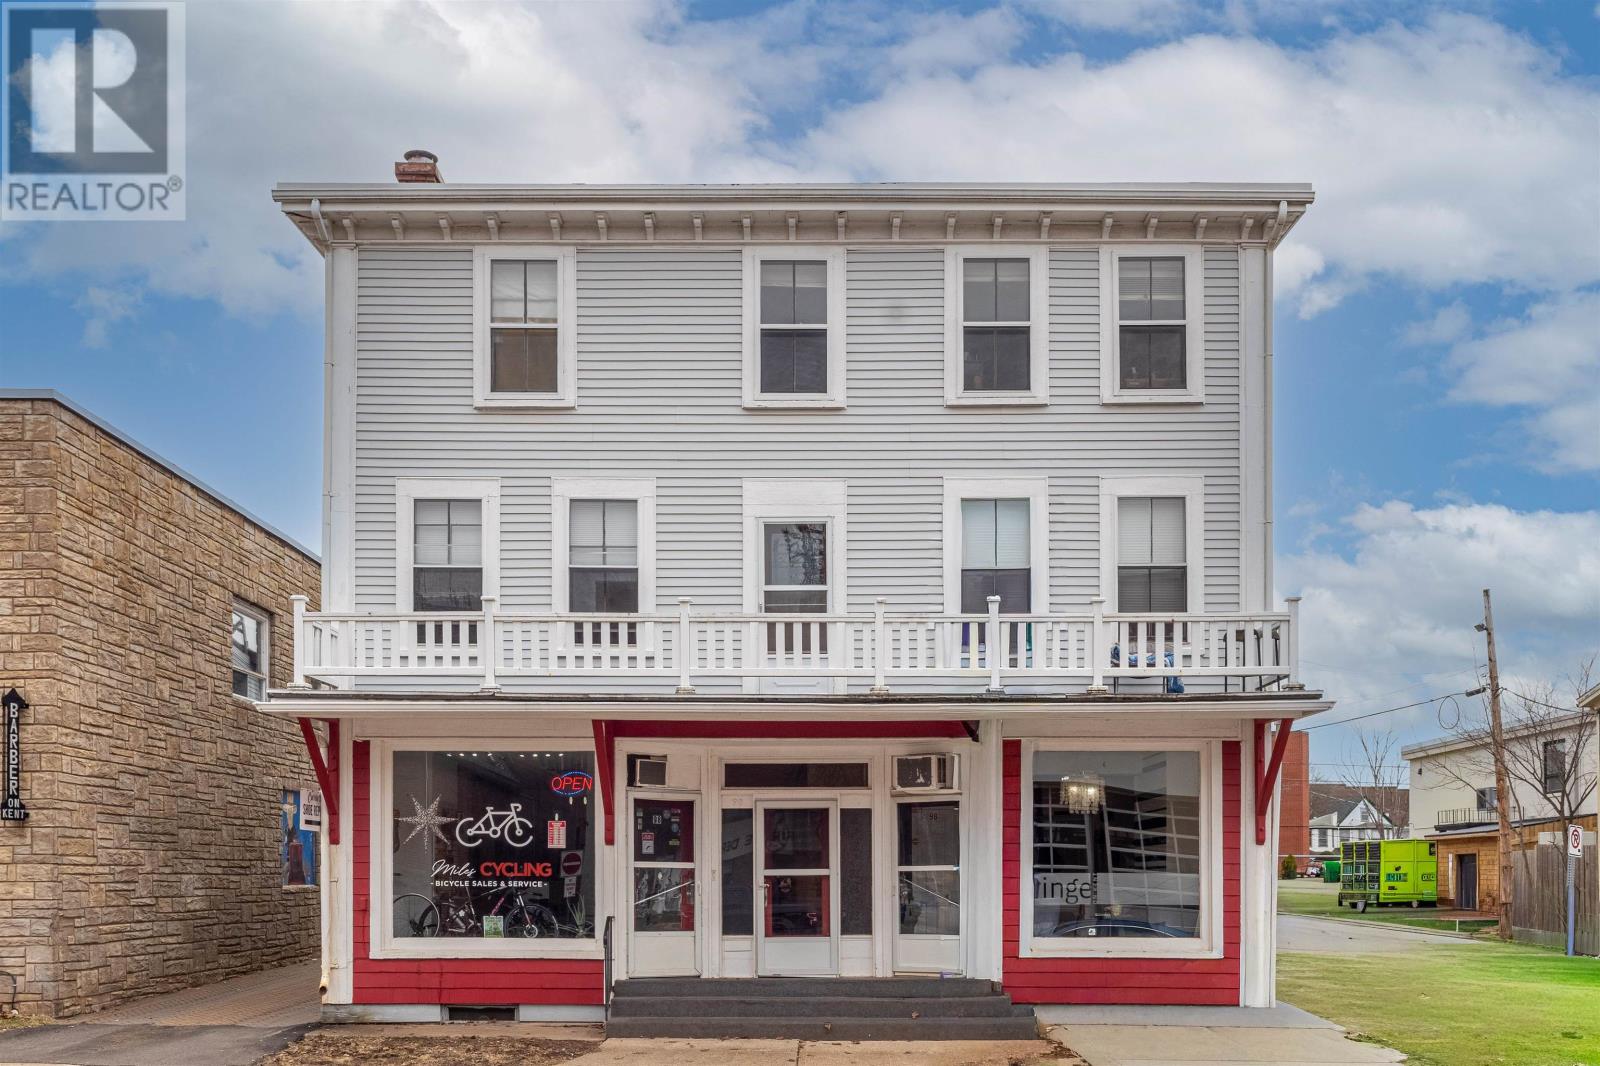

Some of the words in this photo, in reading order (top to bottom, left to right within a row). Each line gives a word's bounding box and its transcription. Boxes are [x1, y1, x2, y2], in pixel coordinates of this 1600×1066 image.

[9, 702, 19, 796] BARBER
[551, 776, 593, 791] OPEN
[8, 798, 20, 808] ON
[2, 808, 25, 819] KENT
[430, 859, 476, 878] Miles
[479, 862, 552, 877] CYCLING
[472, 880, 497, 888] SALES
[498, 880, 505, 888] &
